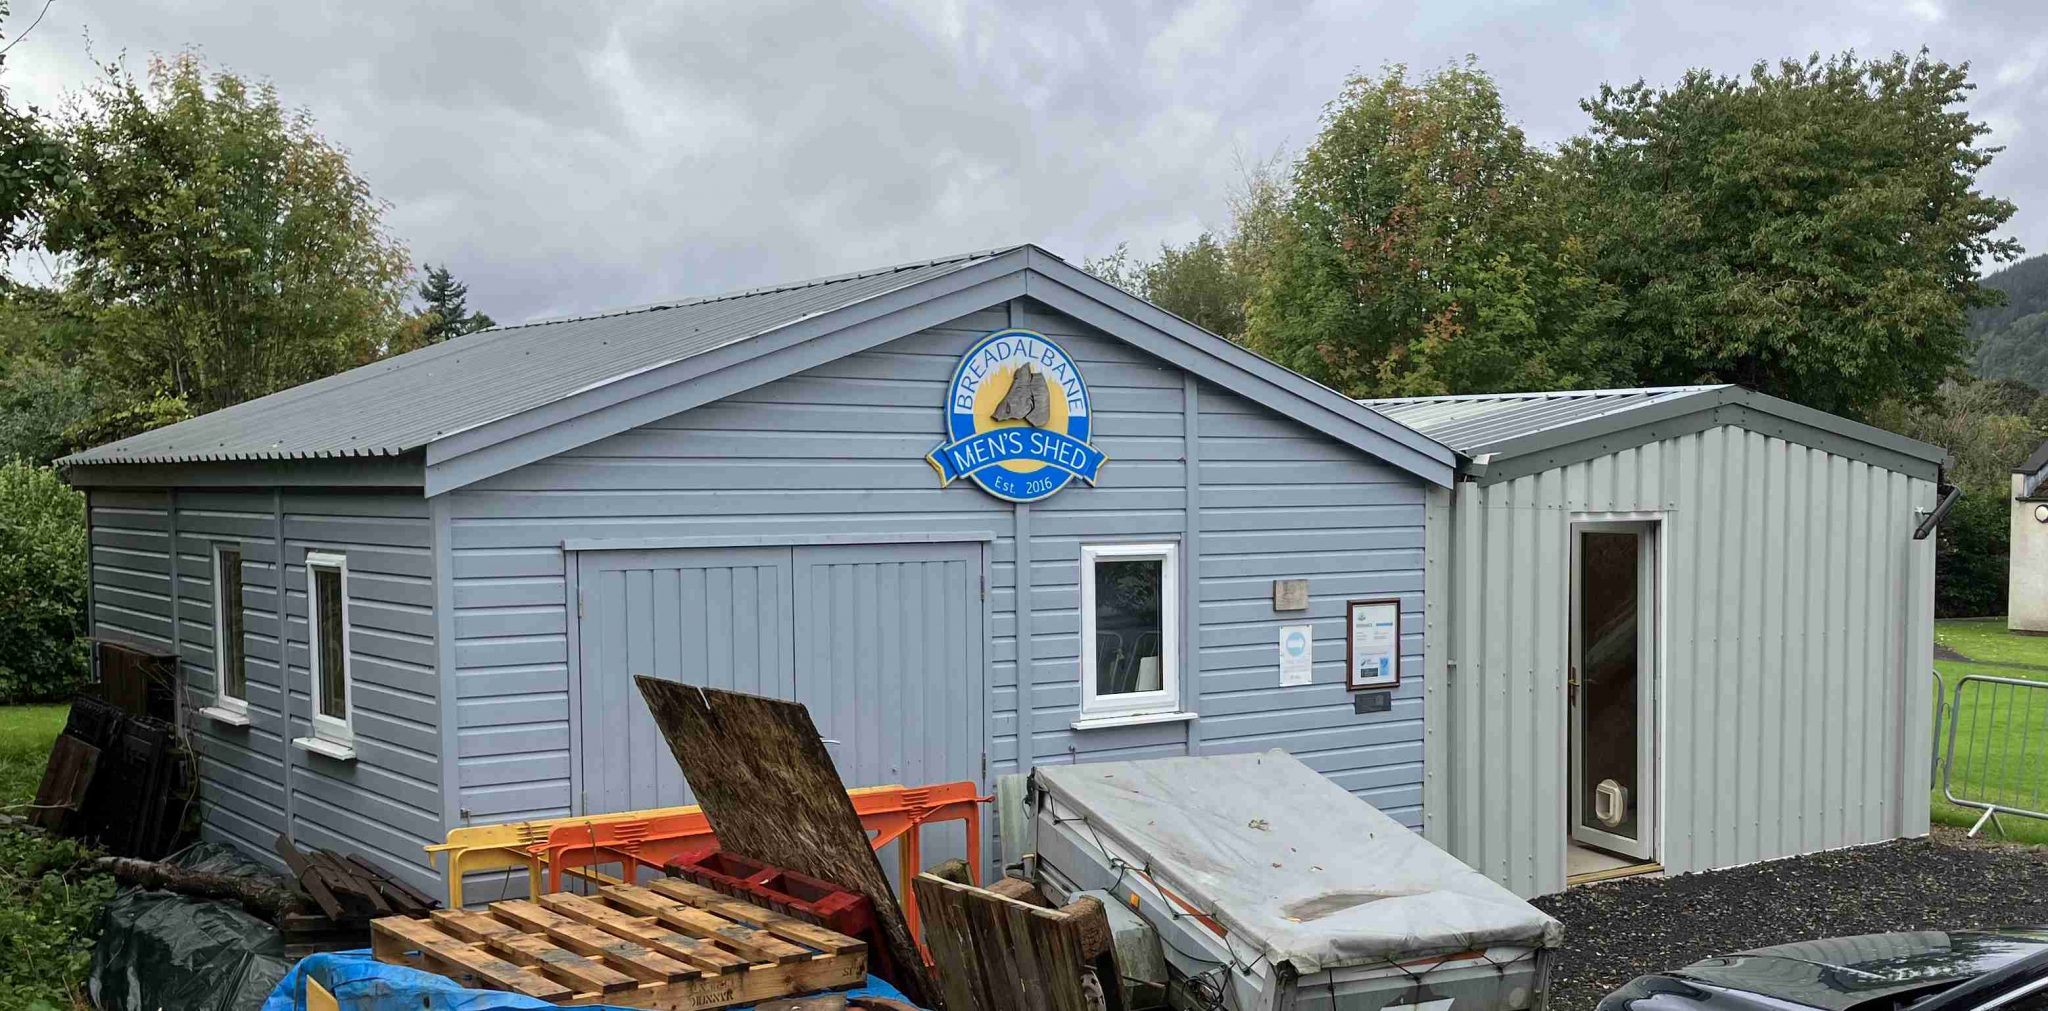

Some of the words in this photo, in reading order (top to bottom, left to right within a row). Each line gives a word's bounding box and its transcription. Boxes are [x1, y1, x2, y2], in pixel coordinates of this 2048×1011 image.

[956, 339, 1083, 412] BREADALBANE
[953, 431, 1024, 471] MEN'S
[1030, 433, 1086, 470] SHED
[995, 475, 1015, 494] Est.
[1026, 477, 1053, 494] 2016
